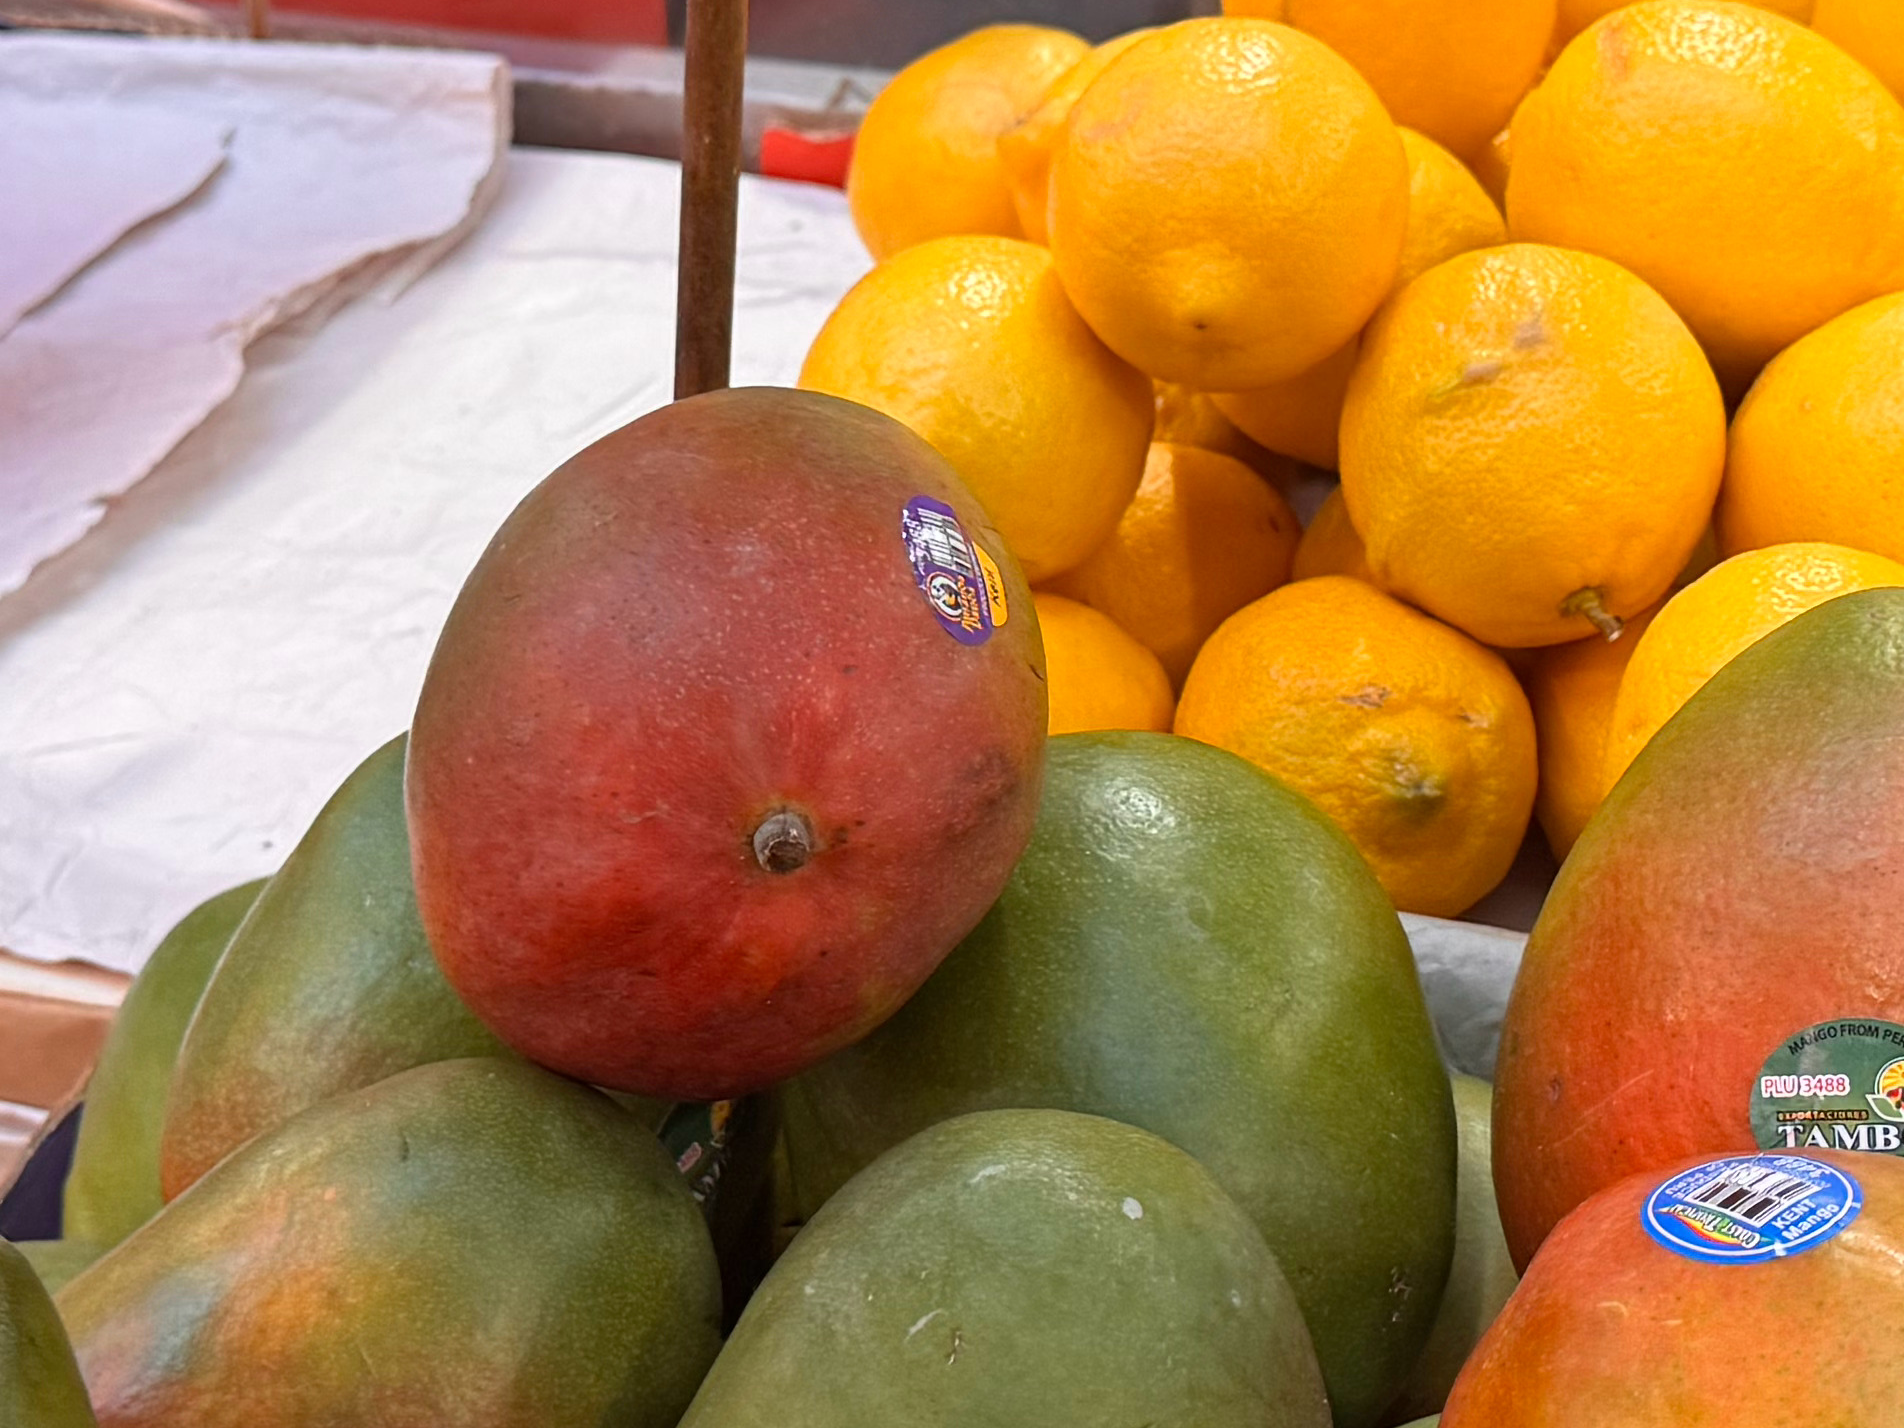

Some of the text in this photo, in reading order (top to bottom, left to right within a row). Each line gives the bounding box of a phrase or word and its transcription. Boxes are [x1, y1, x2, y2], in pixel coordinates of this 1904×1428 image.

[1787, 1025, 1838, 1056] MANGO
[1839, 1022, 1880, 1040] FROM
[1763, 1075, 1849, 1096] PLU 3488
[1771, 1196, 1818, 1232] KENT
[1781, 1202, 1842, 1243] Mango
